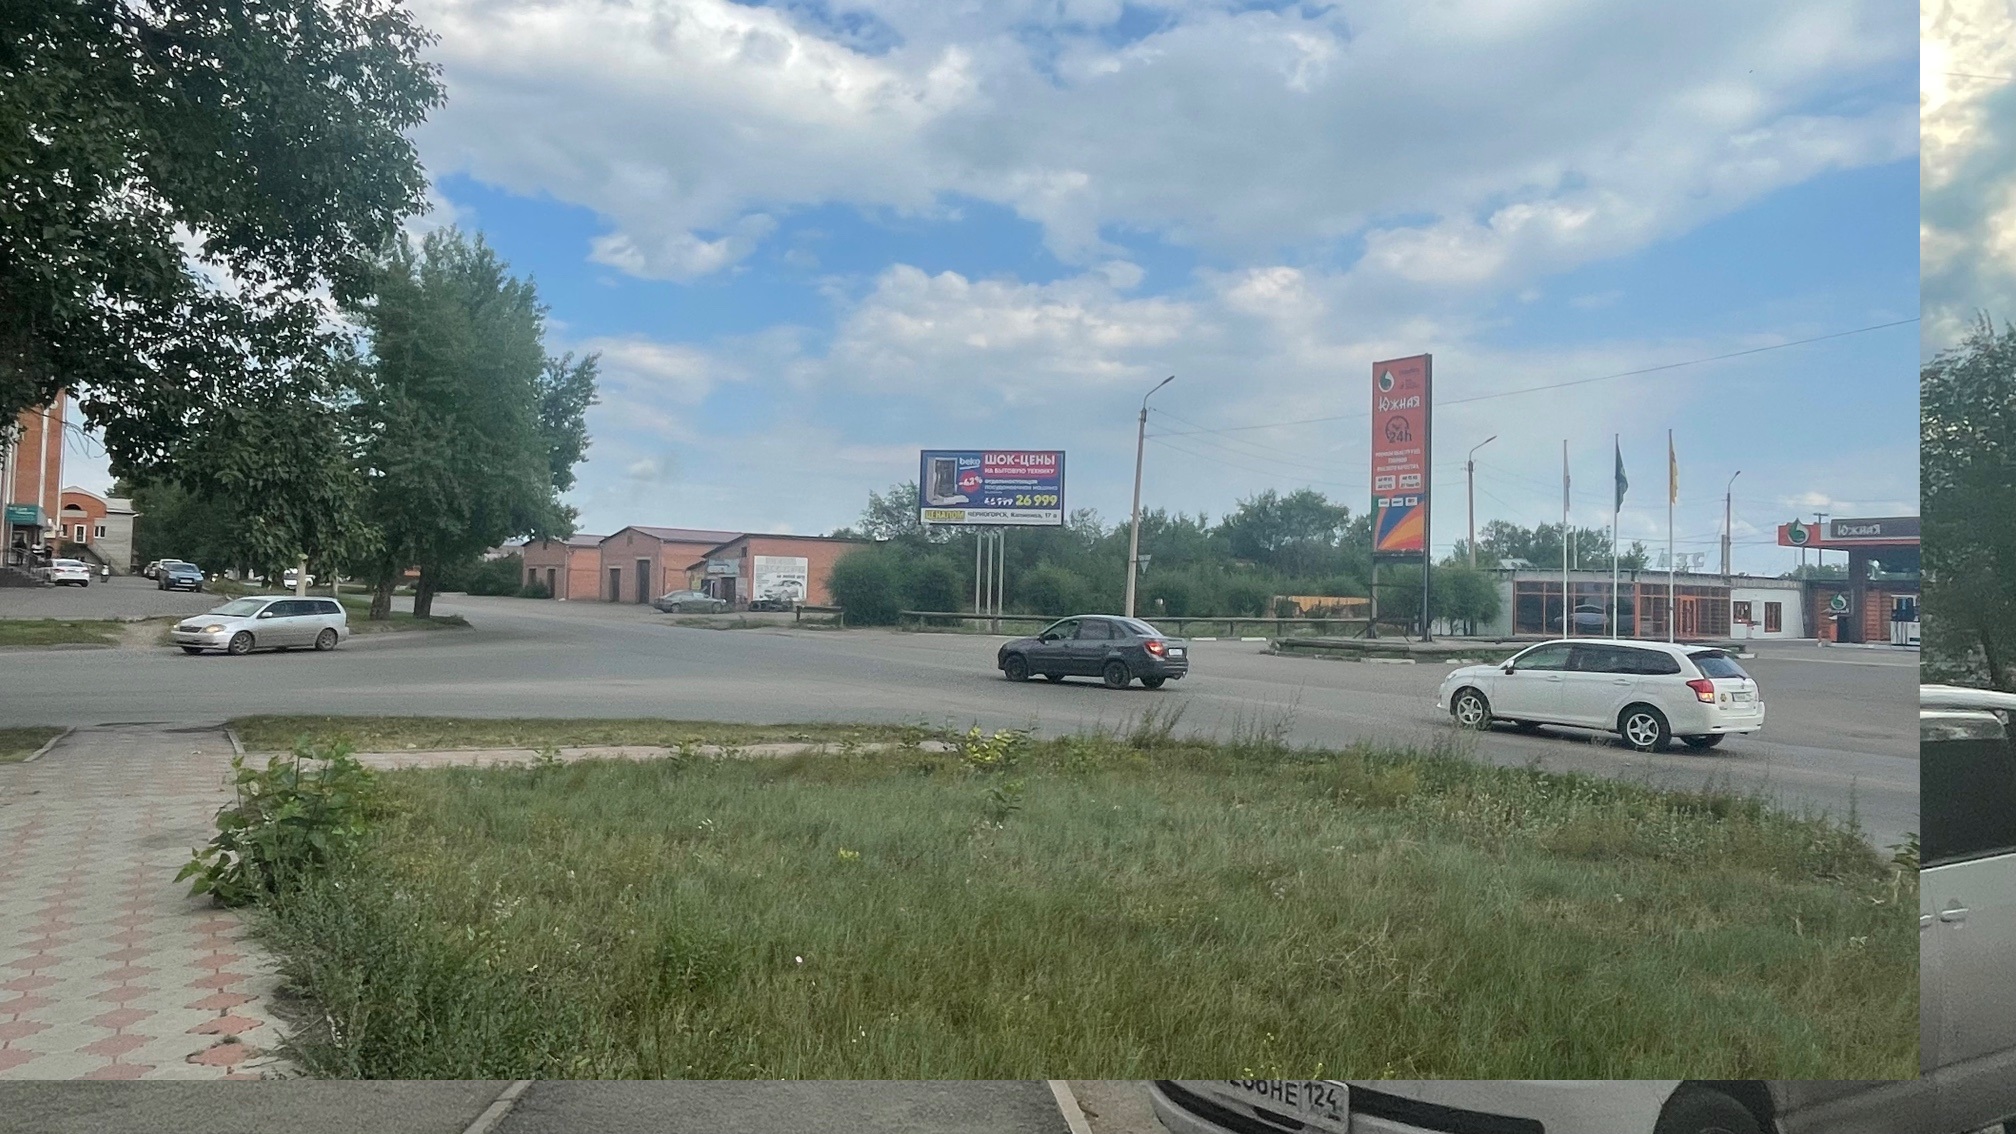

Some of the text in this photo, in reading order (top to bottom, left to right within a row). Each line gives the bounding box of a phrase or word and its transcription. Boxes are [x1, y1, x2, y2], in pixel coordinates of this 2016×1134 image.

[1379, 396, 1420, 412] ЮЖНАЯ
[1389, 430, 1412, 443] 24h
[959, 457, 981, 466] beko
[984, 454, 1056, 467] ШОК-ЦЕНЫ
[1016, 494, 1058, 506] 26 999
[1837, 523, 1881, 536] ЮЖНАЯ
[1304, 1081, 1338, 1111] 124
